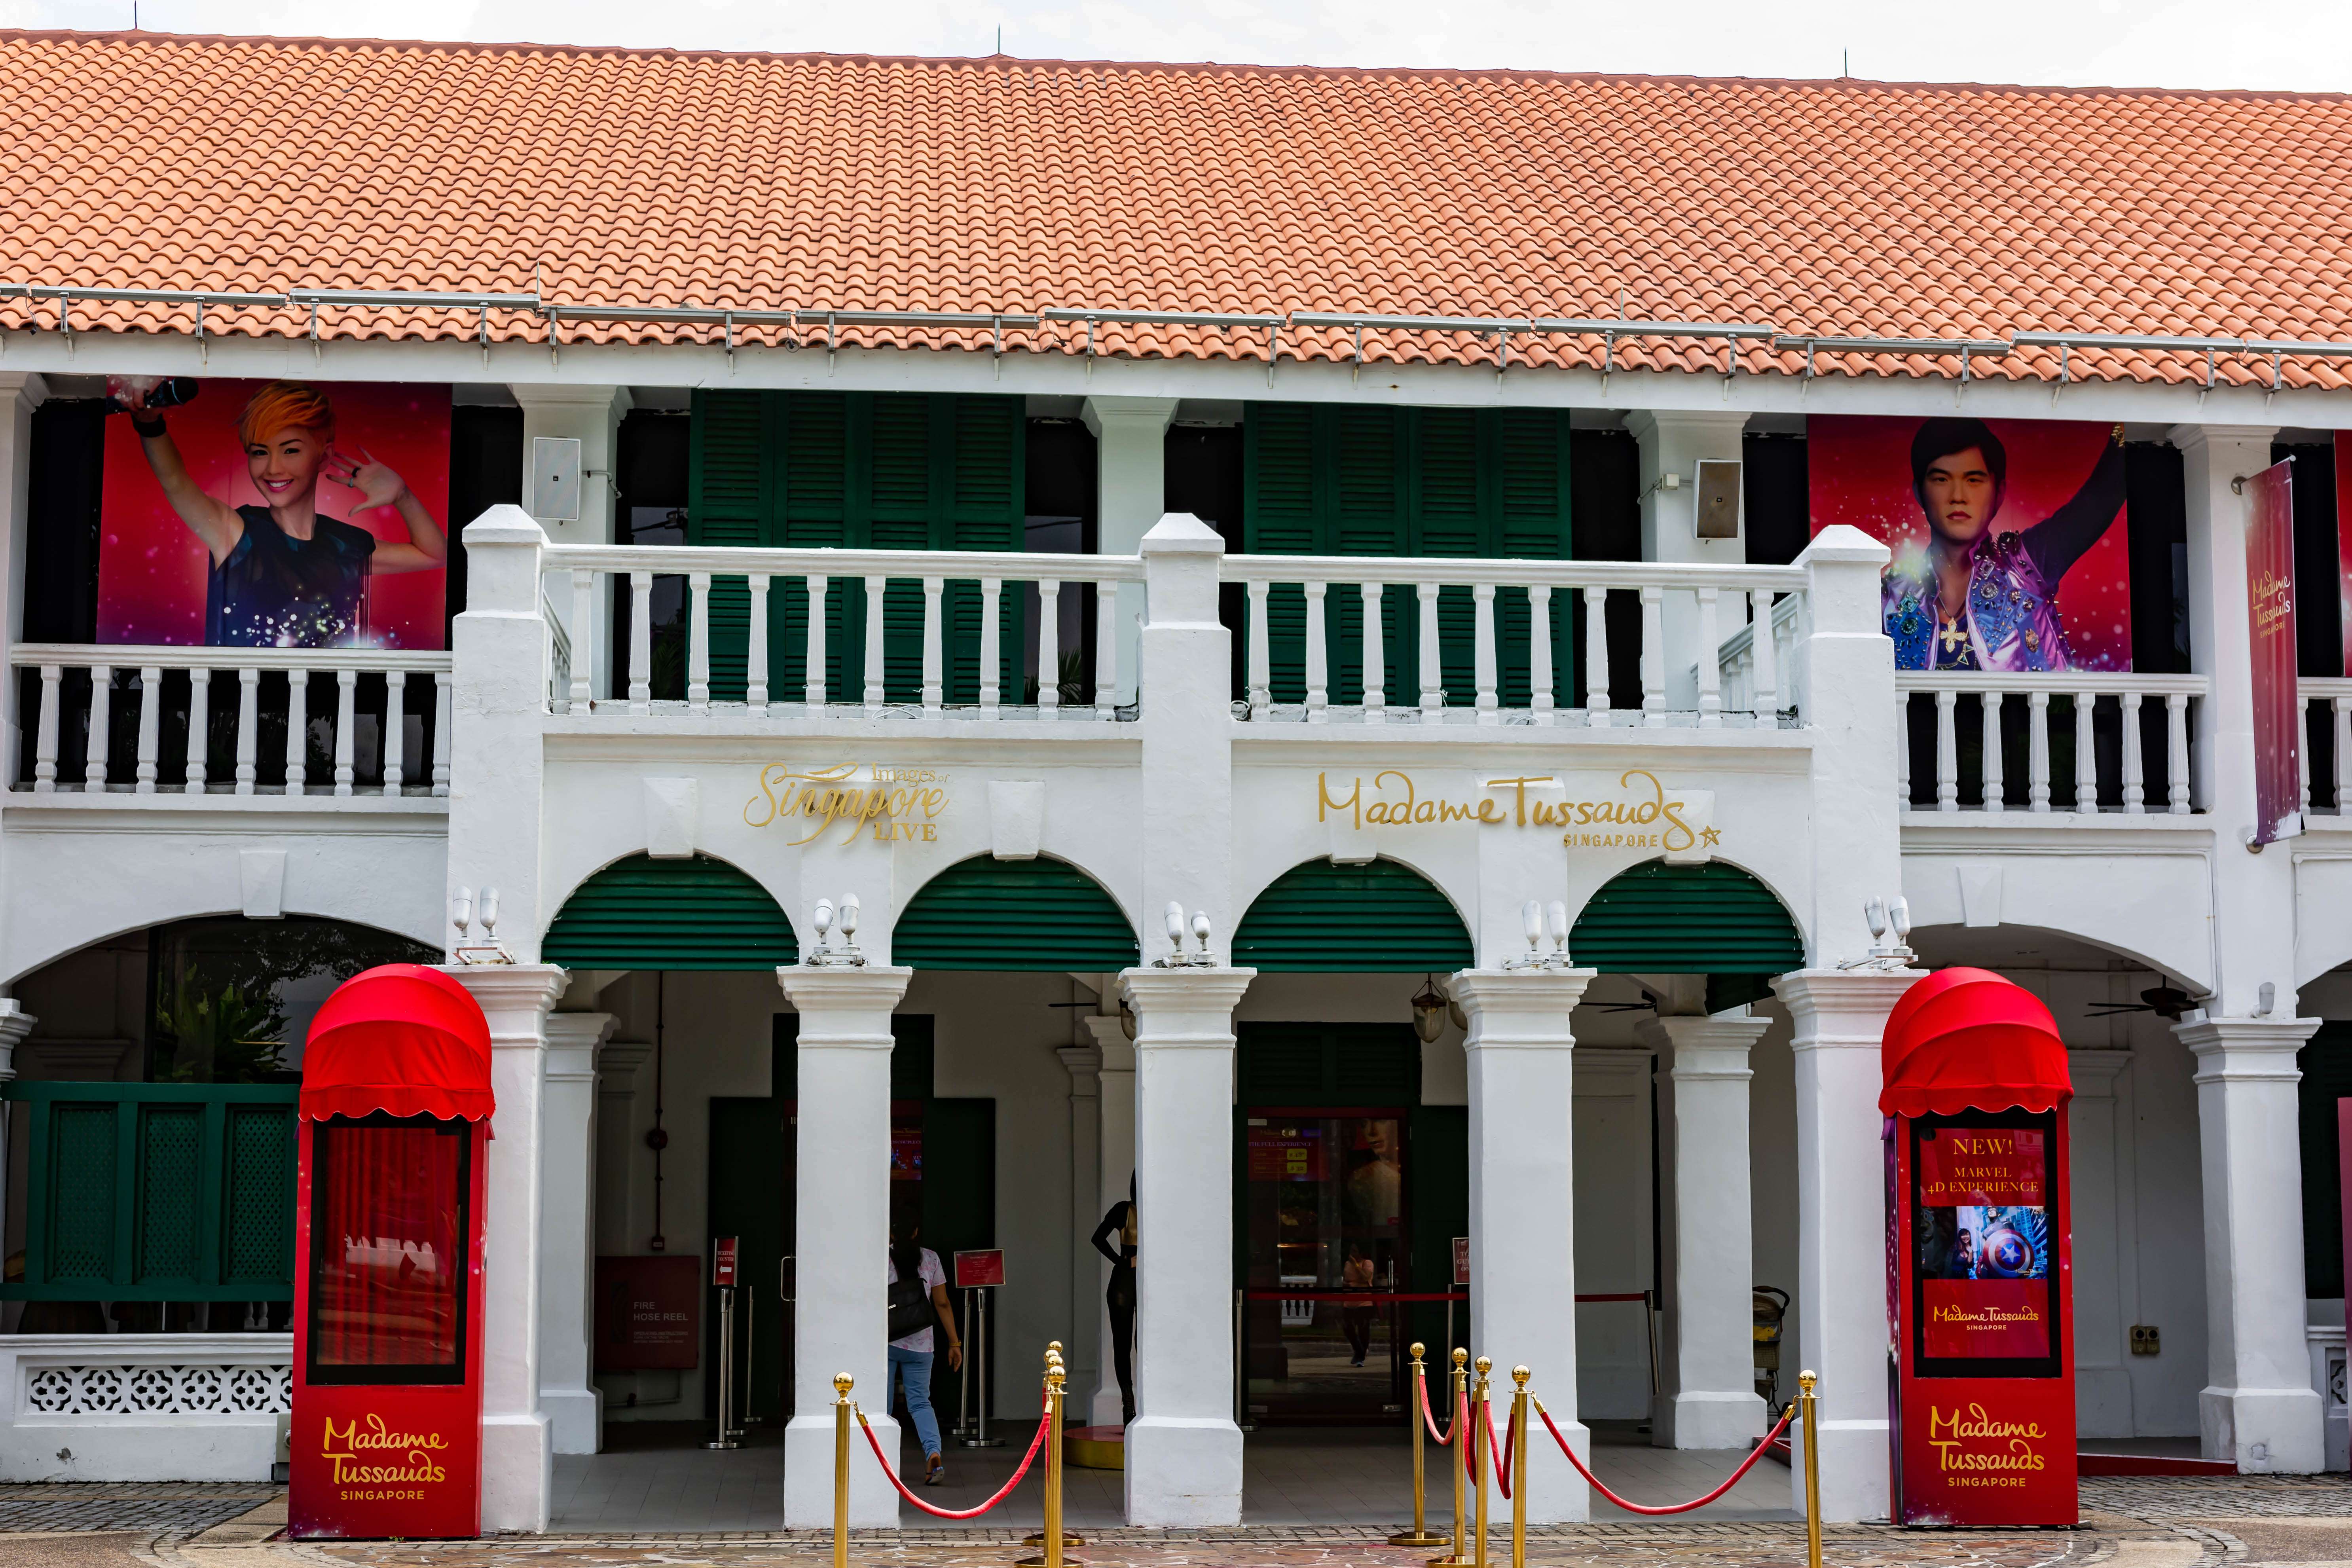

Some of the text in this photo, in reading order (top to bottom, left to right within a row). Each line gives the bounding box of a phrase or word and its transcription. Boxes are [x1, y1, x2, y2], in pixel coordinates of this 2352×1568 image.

[2252, 570, 2291, 604] Madame
[2253, 591, 2291, 628] Tussauds
[2260, 621, 2285, 639] SINGAPORE
[871, 762, 950, 787] Images of
[744, 761, 950, 846] Singapore
[1318, 769, 1695, 851] Madame Tussauds
[873, 823, 937, 842] LIVE
[1563, 834, 1658, 847] SINGAPORE
[1953, 1139, 2012, 1155] NEW!
[1955, 1167, 2011, 1177] MARVEL
[1927, 1182, 2039, 1194] 4D EXPERIENCE
[634, 1301, 656, 1310] FIRE
[1934, 1305, 2039, 1322] Madame Tussauds
[1930, 1403, 2046, 1439] Madame
[323, 1413, 448, 1451] Madame
[1928, 1439, 2045, 1471] Tussauds
[321, 1450, 446, 1484] Tussauds
[1948, 1477, 2026, 1486] SINGAPORE
[341, 1490, 425, 1500] SINGAPORE
